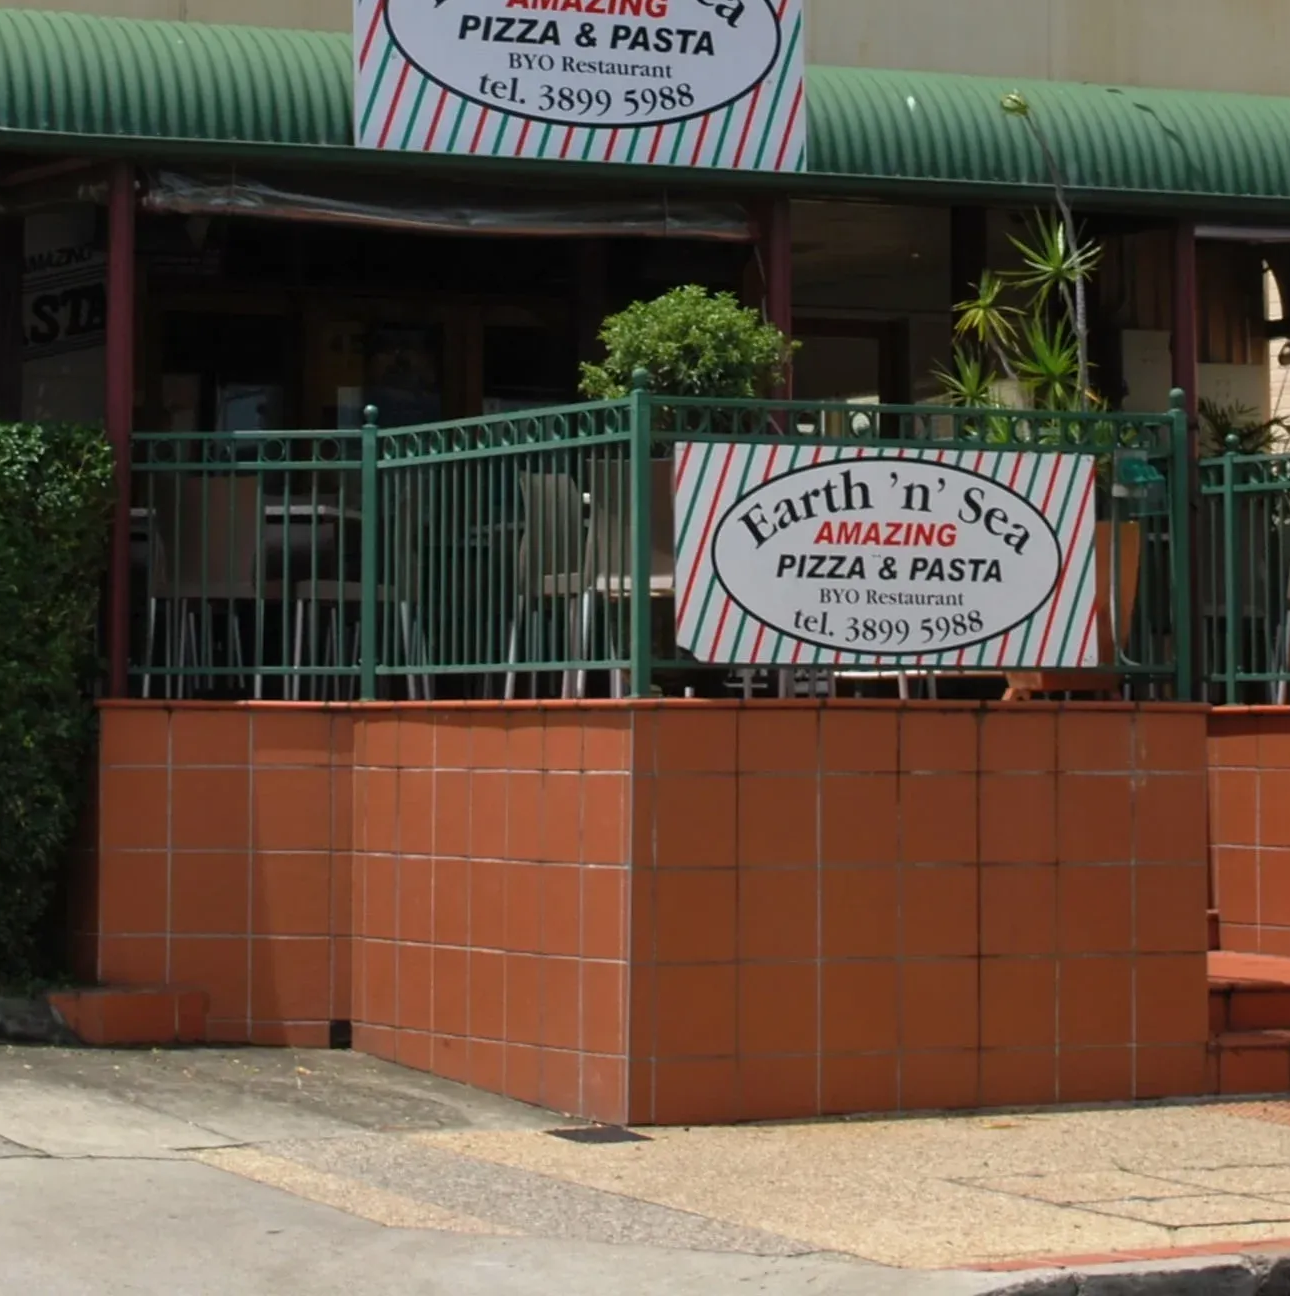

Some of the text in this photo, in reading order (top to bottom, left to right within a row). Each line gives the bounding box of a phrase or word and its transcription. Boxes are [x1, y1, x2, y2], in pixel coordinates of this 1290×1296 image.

[458, 15, 715, 56] PIZZA & PASTA
[508, 52, 672, 79] BYO Restaurant
[479, 72, 695, 117] tel. 3899 5988
[737, 470, 1032, 556] Earth 'n' Sea
[814, 521, 957, 548] AMAZING
[776, 554, 1003, 582] PIZZA & PASTA
[819, 588, 964, 607] BYO Restaurant
[793, 610, 984, 645] tel. 3899 5988
